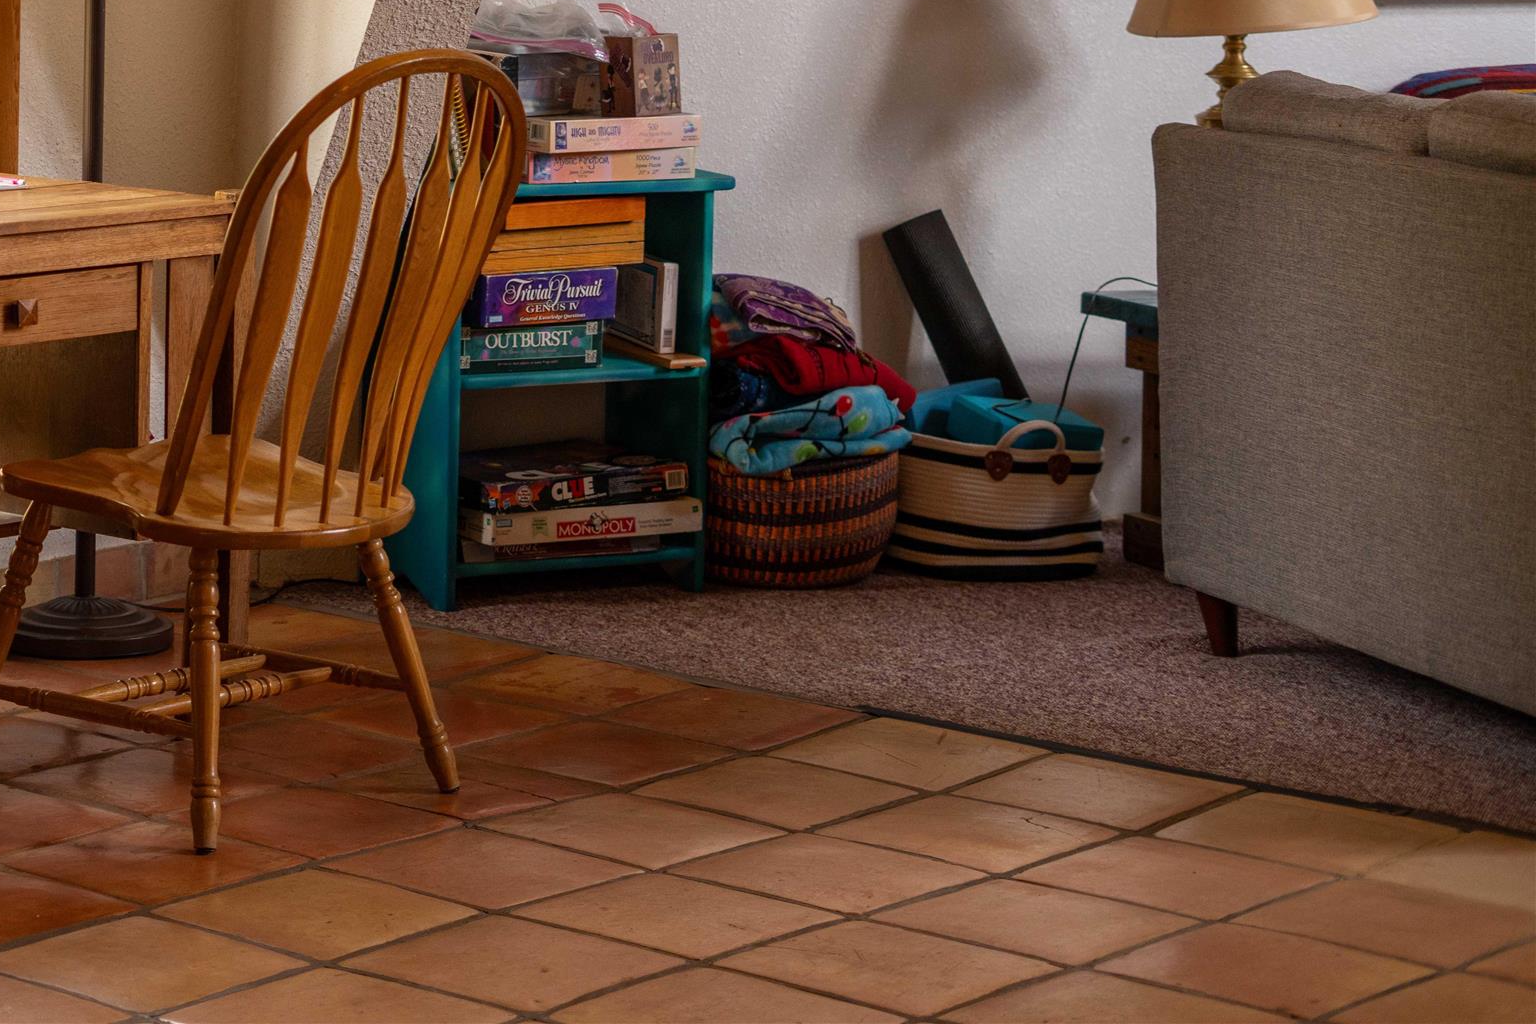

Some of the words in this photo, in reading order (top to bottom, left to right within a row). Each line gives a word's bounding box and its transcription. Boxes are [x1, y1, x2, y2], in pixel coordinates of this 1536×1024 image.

[502, 278, 553, 305] Trivial
[547, 274, 603, 308] Pursuit
[525, 302, 566, 314] GENUS
[569, 301, 580, 311] IV
[485, 329, 573, 349] OUTBURST
[551, 476, 595, 501] CLUE
[558, 518, 635, 536] MONOPOLY
